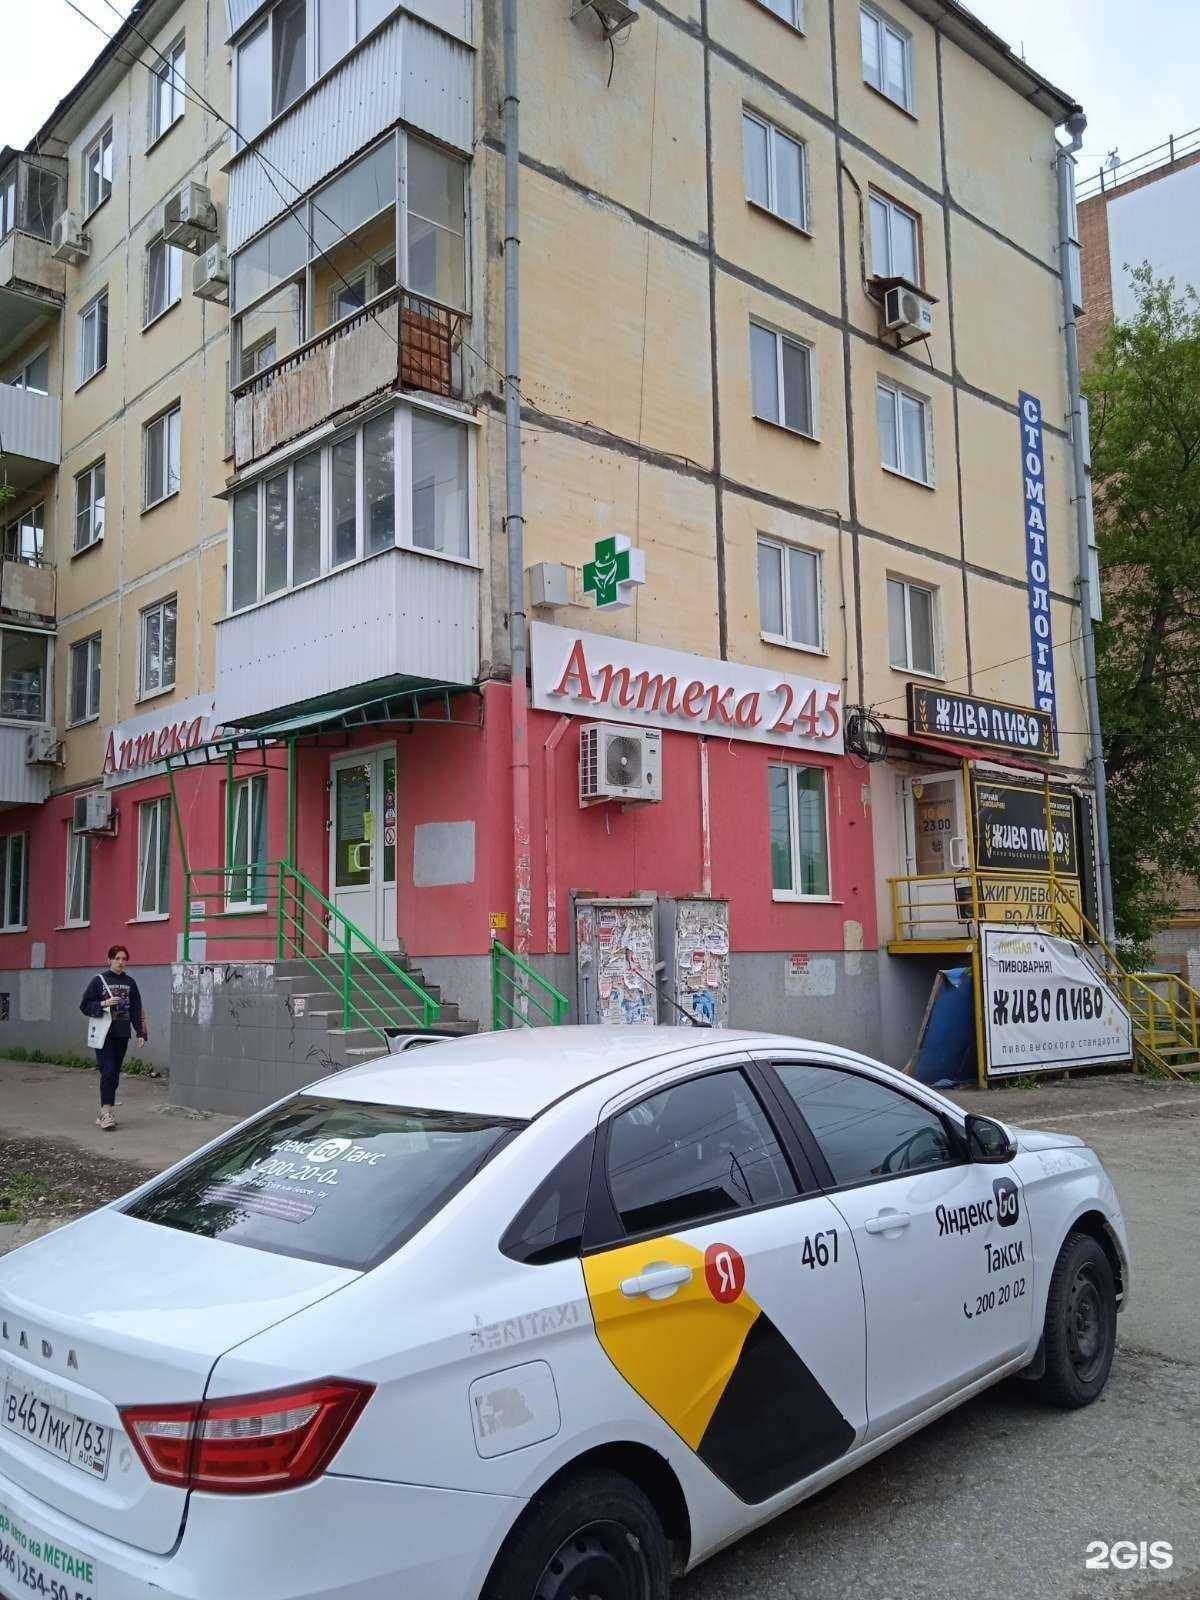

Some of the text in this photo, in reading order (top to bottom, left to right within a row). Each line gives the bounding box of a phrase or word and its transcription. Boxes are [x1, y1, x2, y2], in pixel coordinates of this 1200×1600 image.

[552, 638, 841, 740] Аптека 245
[935, 698, 1039, 746] ЖИВО ПИВО
[102, 715, 204, 775] Аптека
[992, 824, 1028, 850] ЖИВО
[998, 960, 1053, 974] ПИВОВАРНЯ!
[993, 986, 1103, 1026] ЖИВО ПИВО
[1002, 1044, 1026, 1055] пиво
[1029, 1040, 1076, 1053] высокого
[935, 1199, 994, 1237] Яндекс
[801, 1228, 838, 1270] 467
[984, 1240, 1025, 1274] Такси
[715, 1251, 736, 1293] Я
[975, 1278, 1026, 1316] 200 20 02
[2, 1320, 79, 1370] LADA
[75, 1416, 105, 1457] 763
[78, 1451, 93, 1467] RUS
[29, 1538, 41, 1559] на
[43, 1542, 94, 1585] МЕТАНЕ
